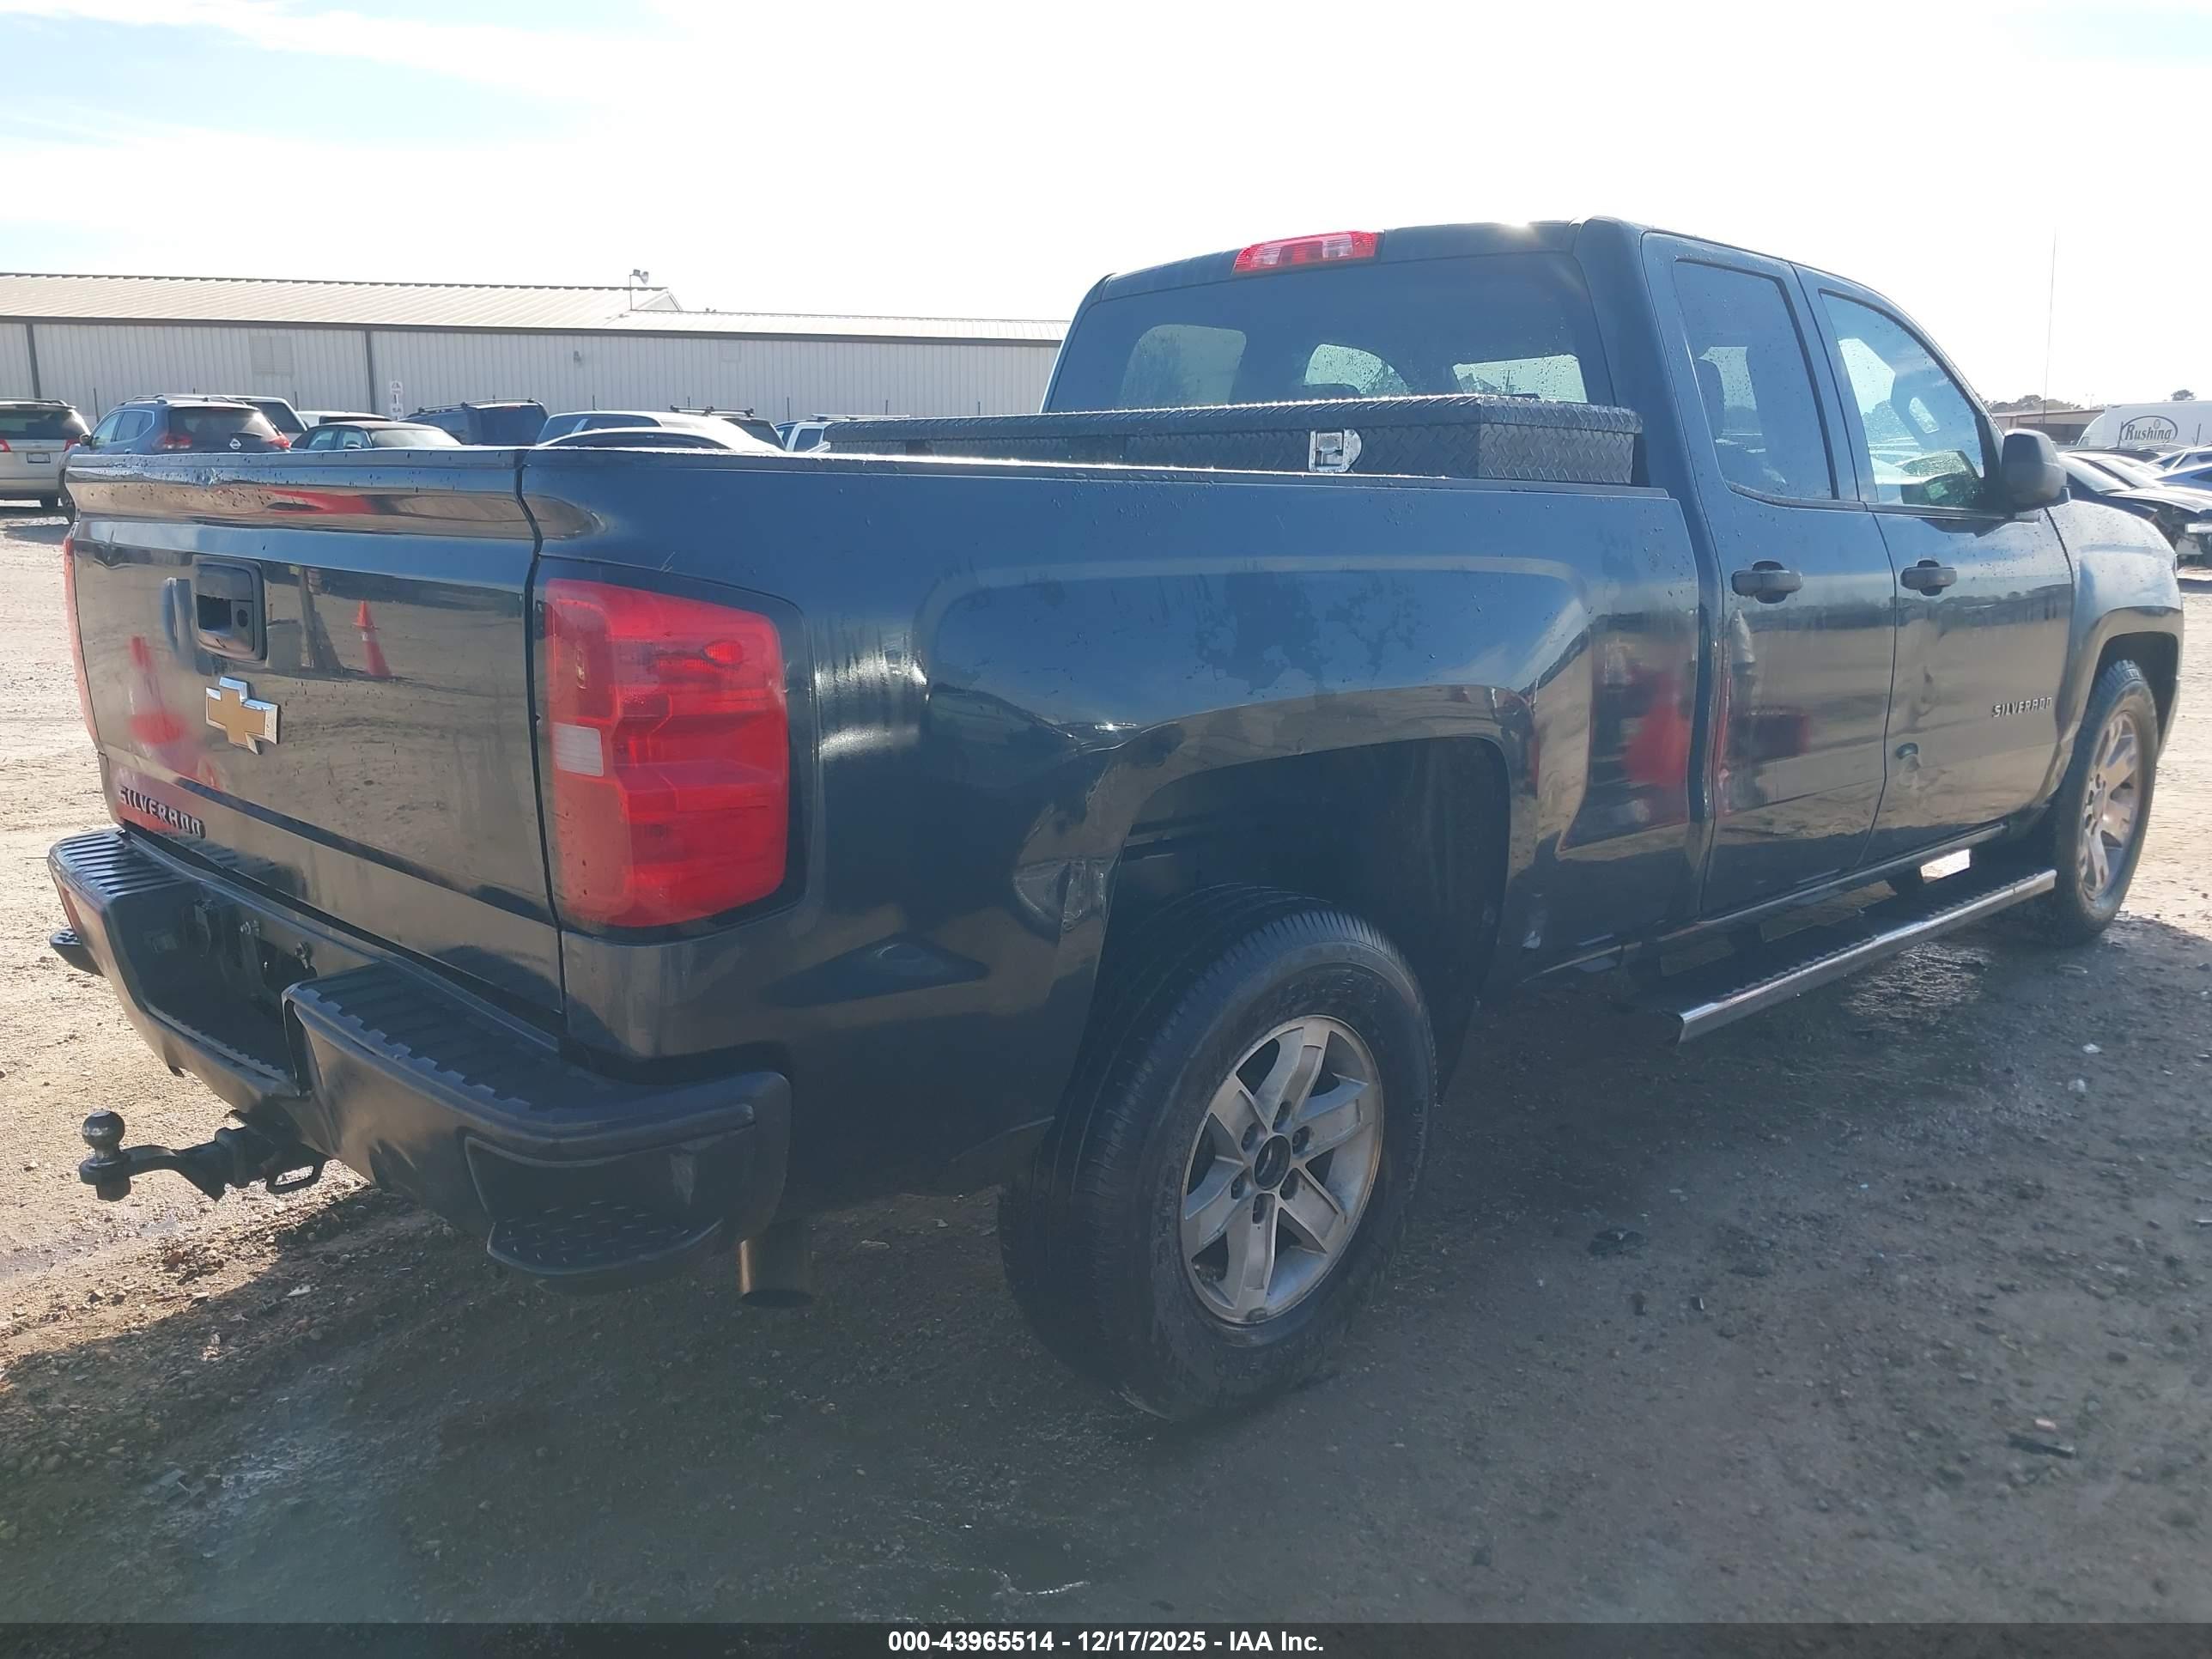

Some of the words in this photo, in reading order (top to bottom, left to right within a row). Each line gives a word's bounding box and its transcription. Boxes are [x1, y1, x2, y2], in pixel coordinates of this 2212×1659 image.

[2124, 424, 2172, 441] Rushing
[1992, 696, 2052, 717] SILVERADO
[118, 787, 205, 838] SILVERADO
